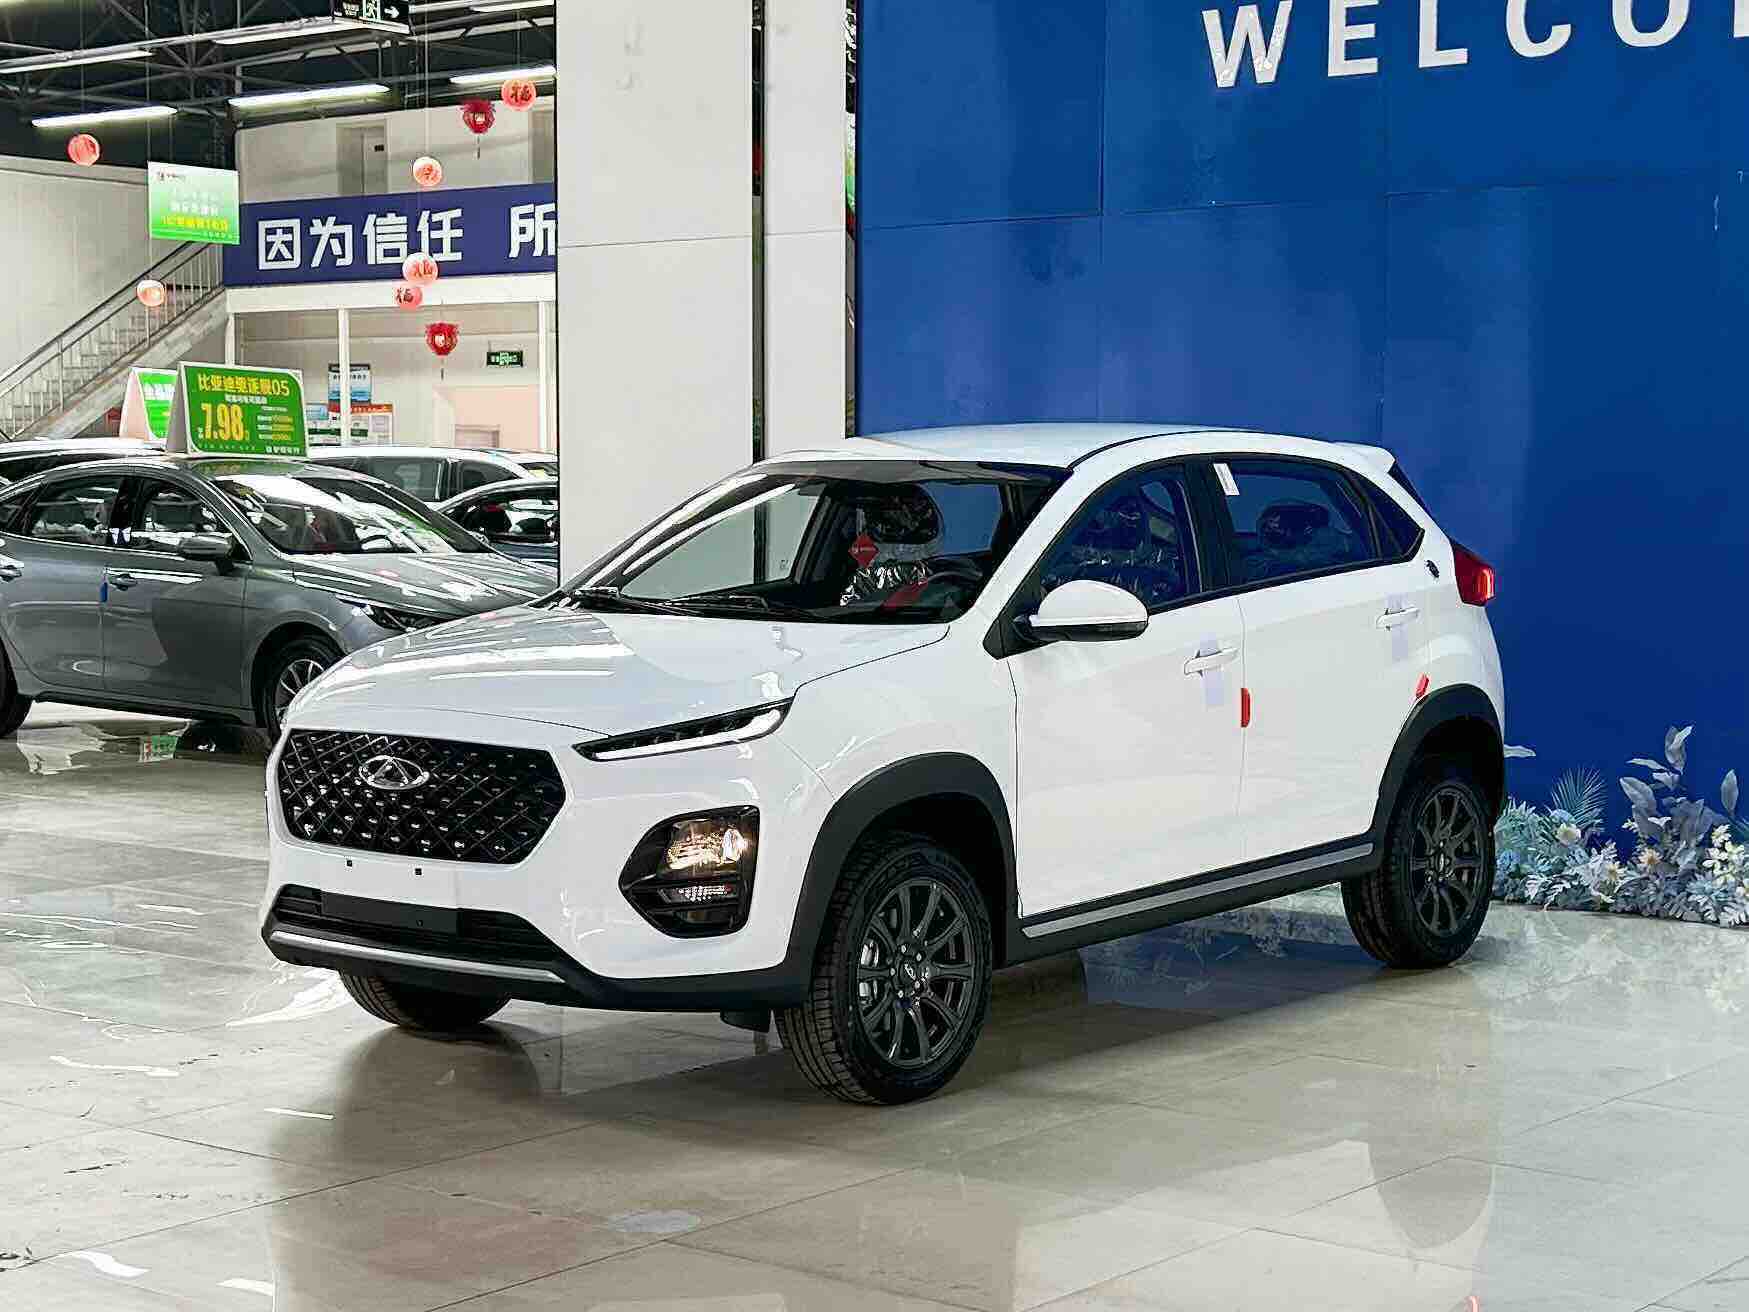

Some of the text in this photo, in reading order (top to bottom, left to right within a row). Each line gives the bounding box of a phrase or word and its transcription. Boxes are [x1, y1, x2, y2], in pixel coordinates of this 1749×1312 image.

[1202, 0, 1749, 88] WELCO
[258, 203, 556, 270] 因为信任 所
